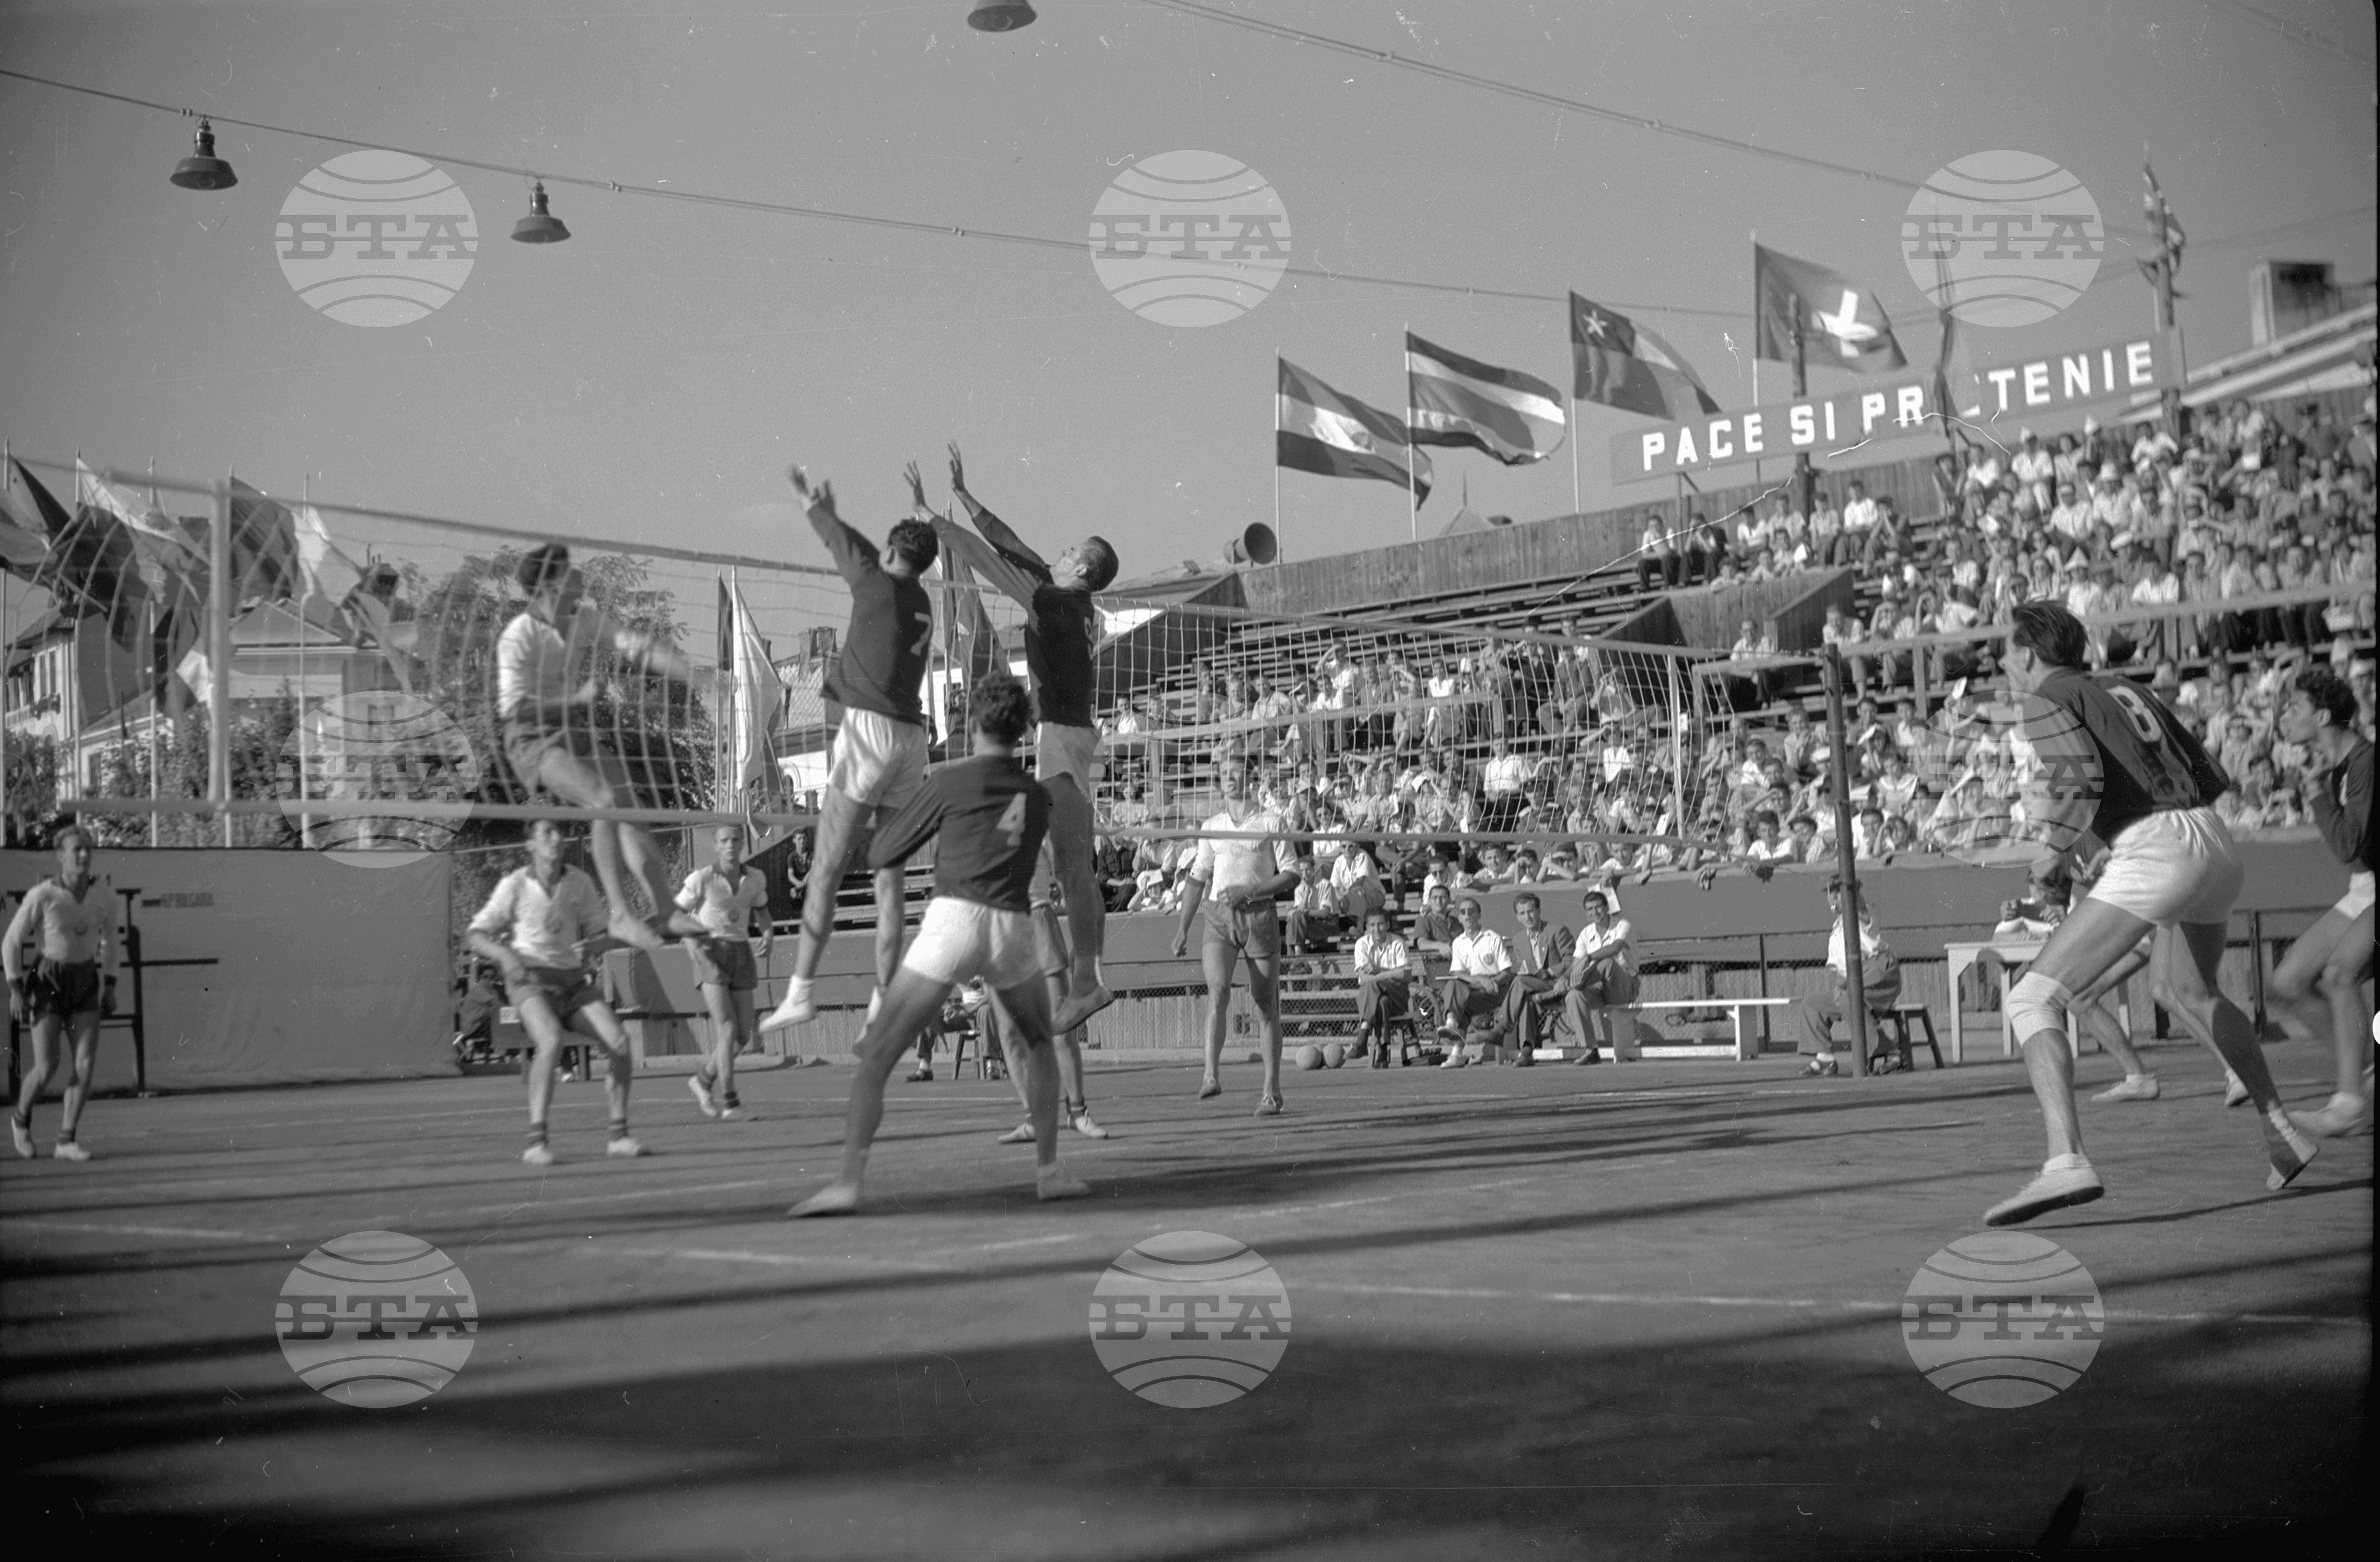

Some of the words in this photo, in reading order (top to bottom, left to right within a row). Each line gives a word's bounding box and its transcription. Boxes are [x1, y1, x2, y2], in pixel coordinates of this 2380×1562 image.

[1642, 412, 1764, 471] PACE
[1790, 400, 1836, 446] SI
[1861, 340, 2153, 434] PRTENIE
[910, 611, 933, 657] 7
[2107, 685, 2162, 744] 8
[997, 792, 1028, 848] 4
